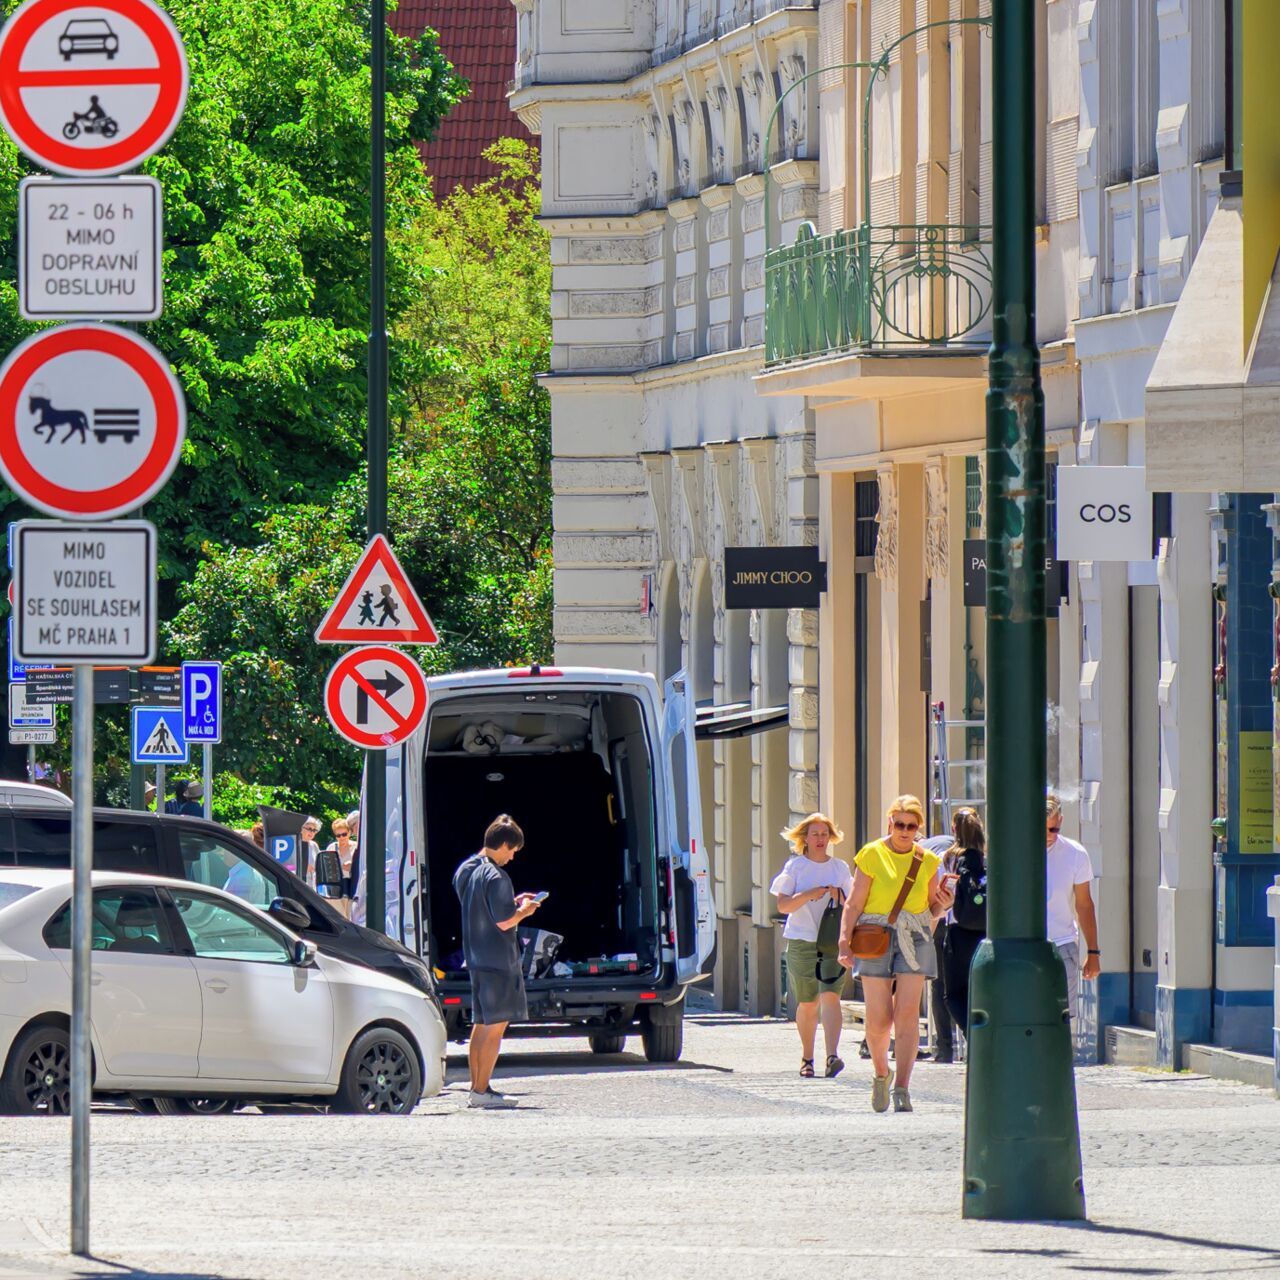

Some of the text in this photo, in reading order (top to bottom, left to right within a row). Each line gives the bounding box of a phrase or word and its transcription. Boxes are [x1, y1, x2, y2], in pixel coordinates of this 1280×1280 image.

[48, 204, 69, 221] 22
[93, 204, 115, 220] 06
[123, 204, 134, 220] h
[66, 228, 115, 245] MIMO
[42, 250, 139, 271] DOPRAVNÍ
[45, 278, 136, 296] OBSLUHU
[1080, 504, 1131, 523] COS
[63, 542, 106, 560] MIMO
[53, 570, 116, 589] VOZIDEL
[732, 571, 812, 585] JIMMY CHOO
[27, 598, 141, 617] SE SOUHLASEM
[39, 623, 130, 646] MČ PRAHA 1
[191, 673, 212, 717] P
[276, 839, 288, 860] P
